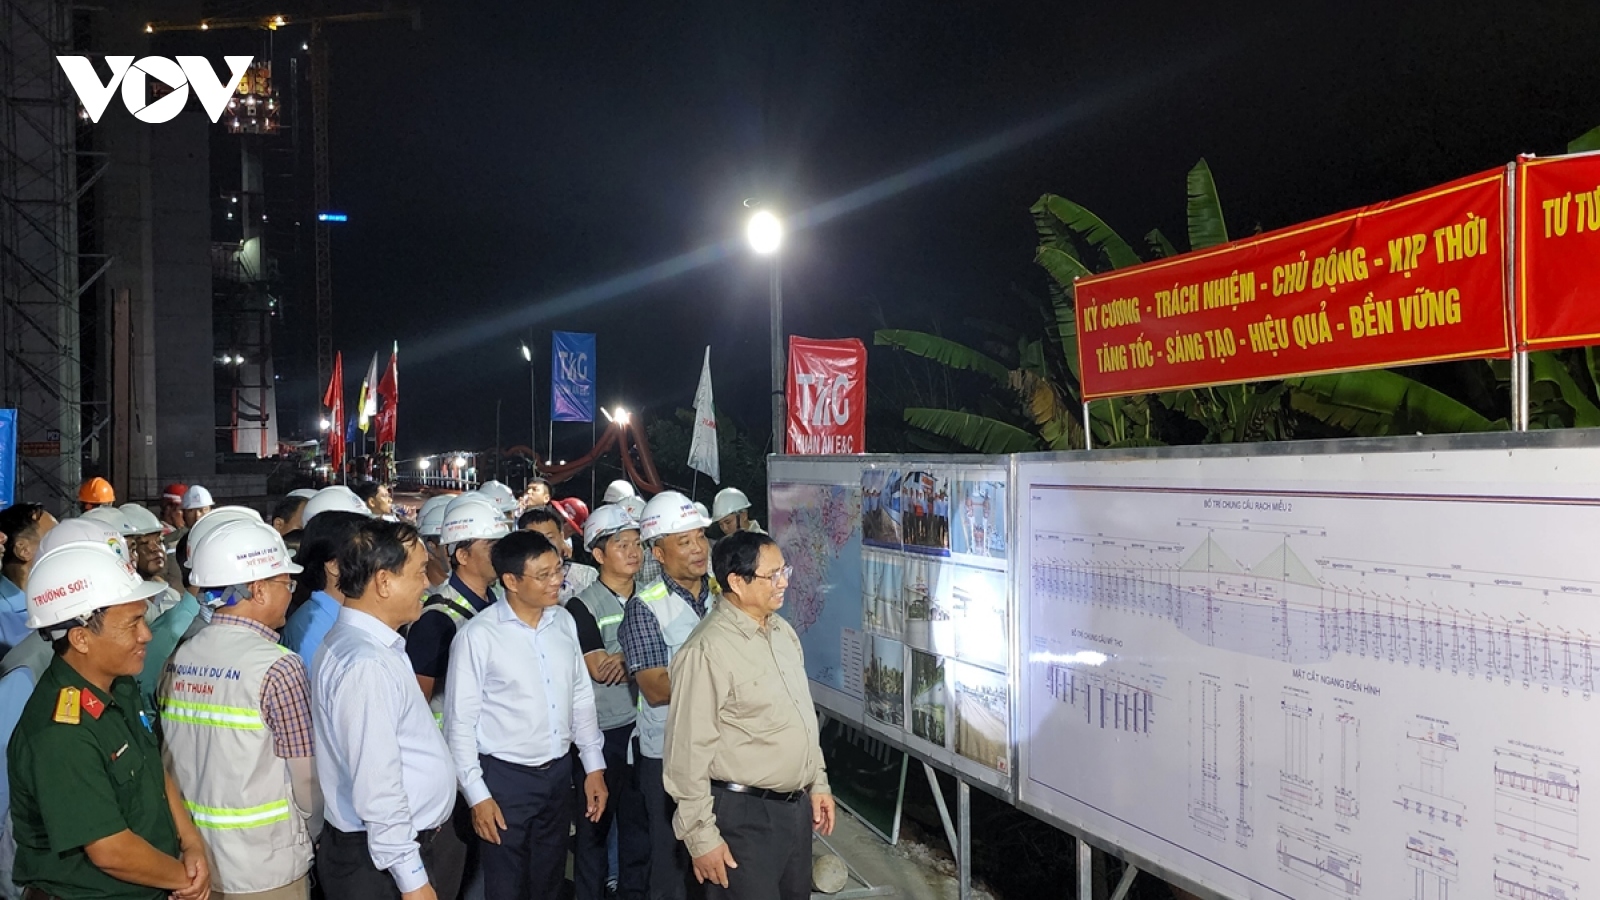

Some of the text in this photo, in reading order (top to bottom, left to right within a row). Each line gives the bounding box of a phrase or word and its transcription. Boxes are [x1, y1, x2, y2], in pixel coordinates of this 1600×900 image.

[1542, 191, 1572, 239] TƯ
[1084, 298, 1098, 332] KỶ
[1101, 297, 1141, 330] CƯƠNG
[1155, 282, 1200, 318] TRÁCH
[1203, 269, 1256, 311] NHIỆM
[1272, 250, 1310, 297] CHỦ
[1311, 247, 1369, 293] ĐỘNG
[1433, 211, 1487, 264] THỜI
[1096, 342, 1128, 373] TĂNG
[1131, 332, 1154, 368] TỐC
[1165, 330, 1205, 364] SÁNG
[1204, 327, 1236, 363] TẠO
[1248, 314, 1289, 357] HIỆU
[1292, 301, 1333, 349] QUẢ
[1349, 291, 1394, 339] BỀN
[1399, 286, 1462, 331] VỮNG
[177, 662, 198, 676] QUẢN
[225, 666, 240, 680] ÁN
